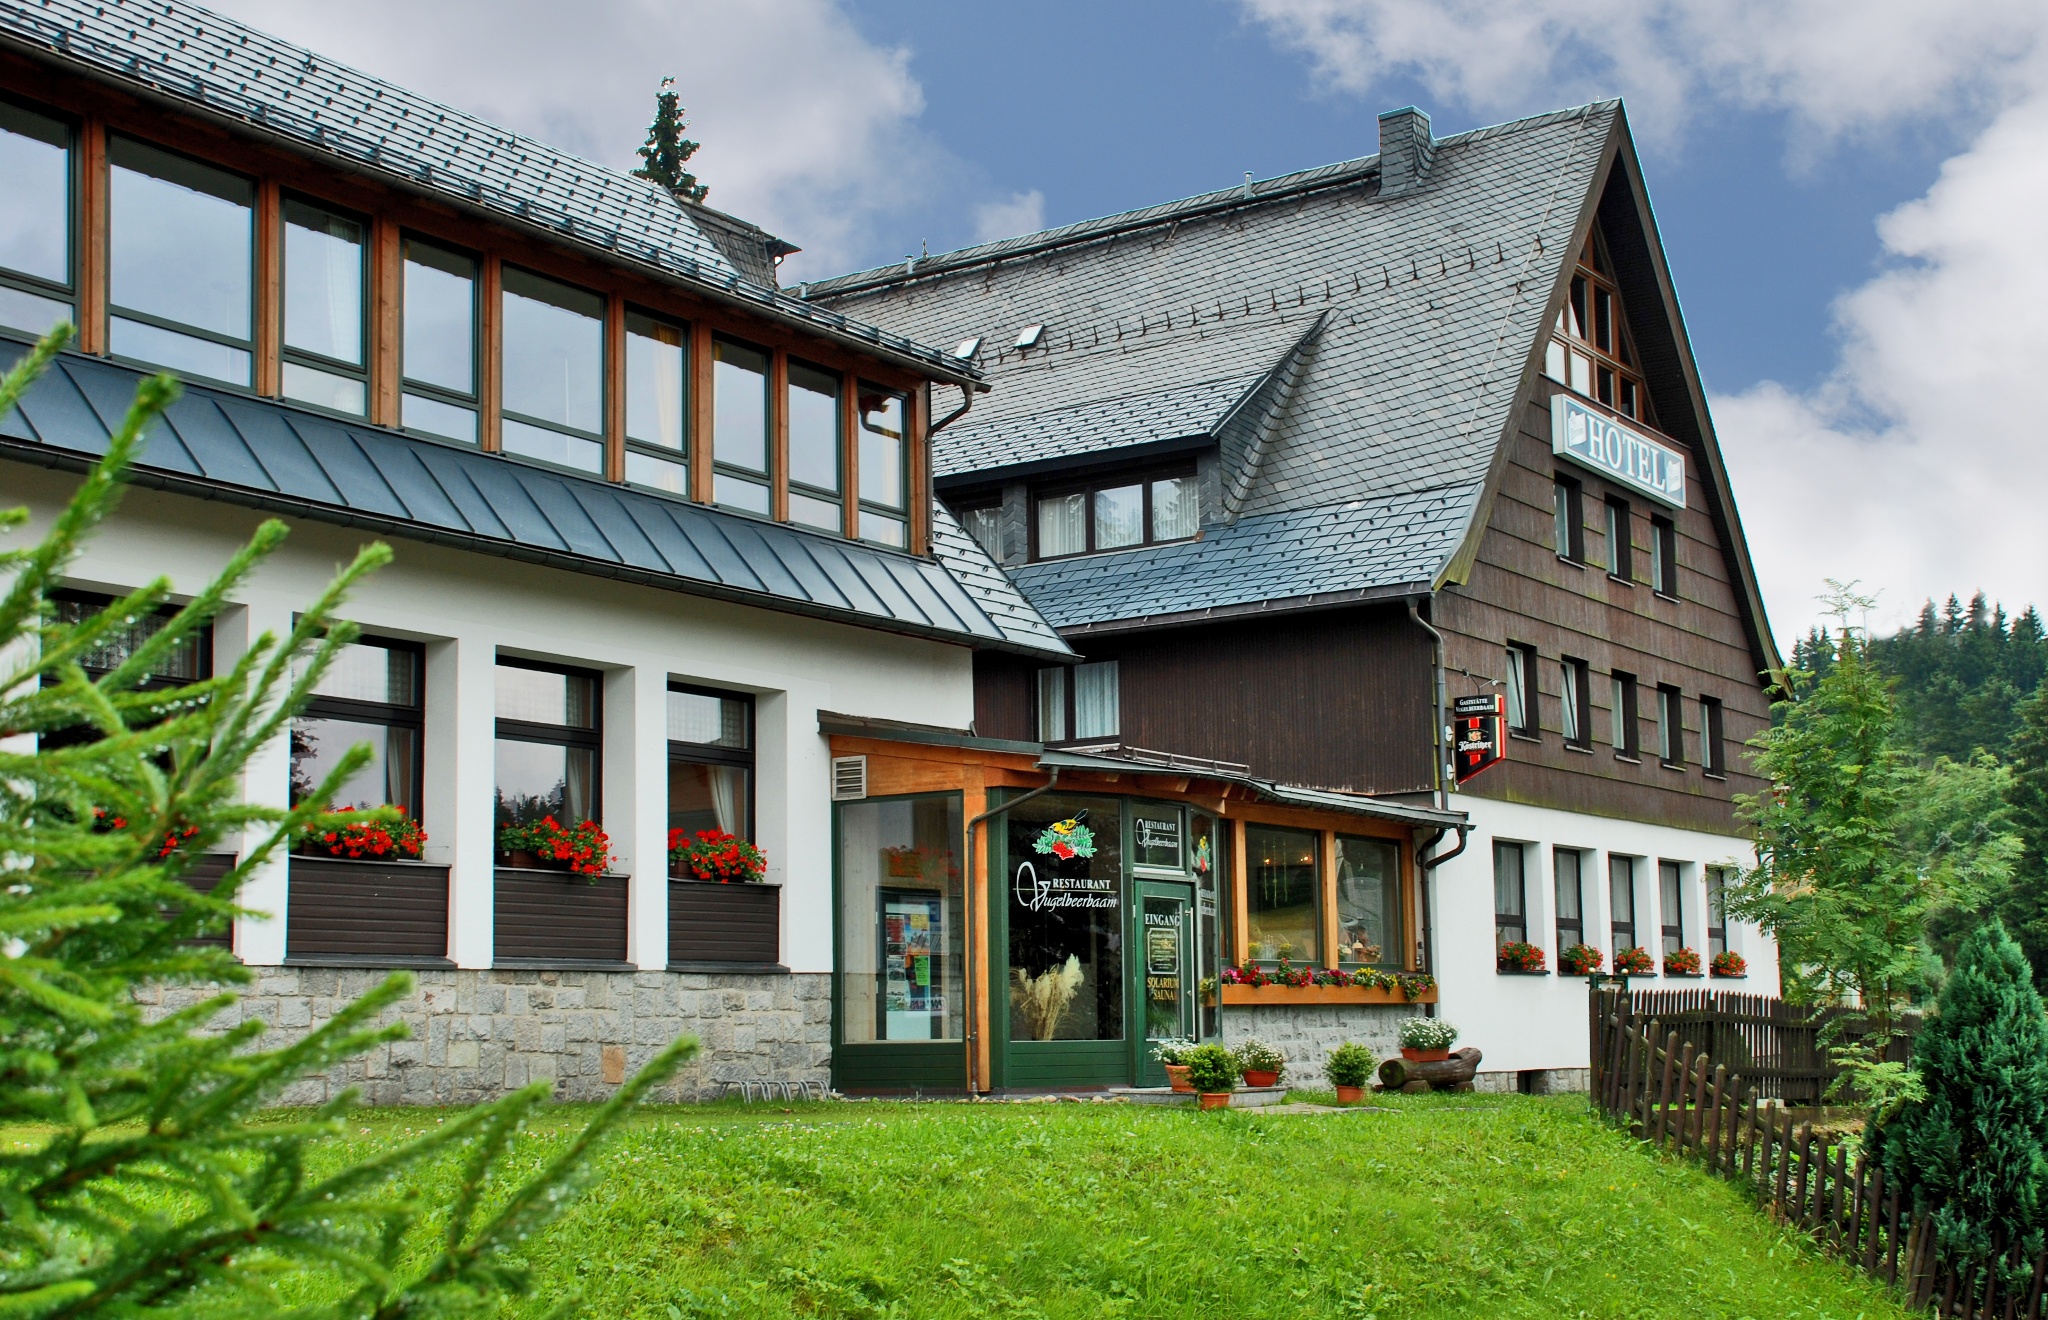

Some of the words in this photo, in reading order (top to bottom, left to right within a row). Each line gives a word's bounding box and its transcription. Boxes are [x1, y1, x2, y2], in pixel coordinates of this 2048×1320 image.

[1586, 415, 1666, 491] HOTEL
[1144, 820, 1176, 831] RESTAURANT
[1016, 861, 1118, 912] Vugelbeerbaam
[1052, 878, 1111, 890] RESTAURANT
[1144, 913, 1180, 926] EINGANG
[1147, 976, 1180, 989] SOLARIUM
[1153, 989, 1174, 1001] SAUNA
